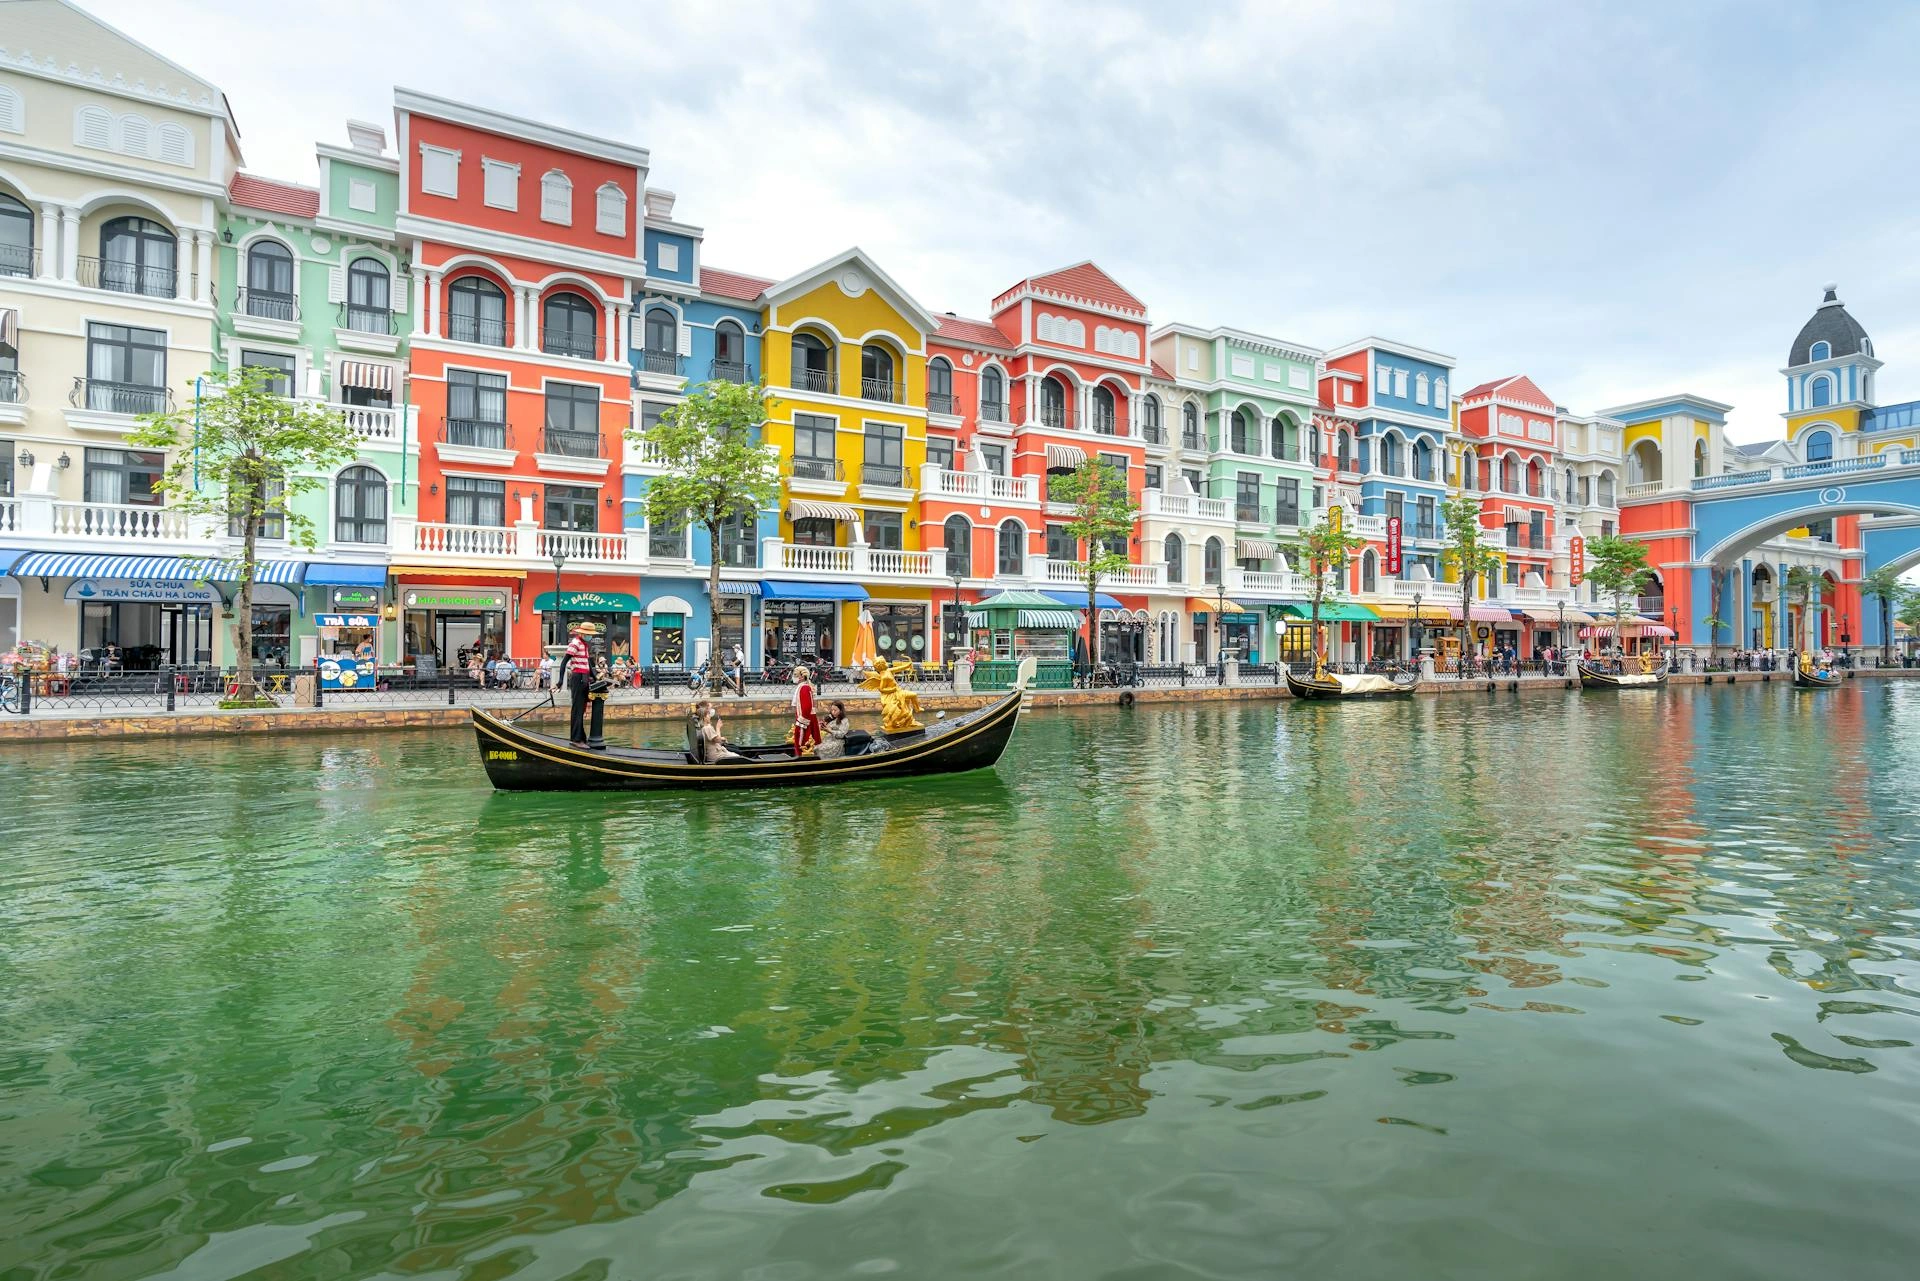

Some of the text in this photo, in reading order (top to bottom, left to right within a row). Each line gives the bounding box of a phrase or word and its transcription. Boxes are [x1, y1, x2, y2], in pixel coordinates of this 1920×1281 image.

[1572, 539, 1581, 572] SIMBA
[154, 581, 185, 590] CHUA
[183, 591, 211, 599] LONG
[571, 593, 606, 605] BAKERY
